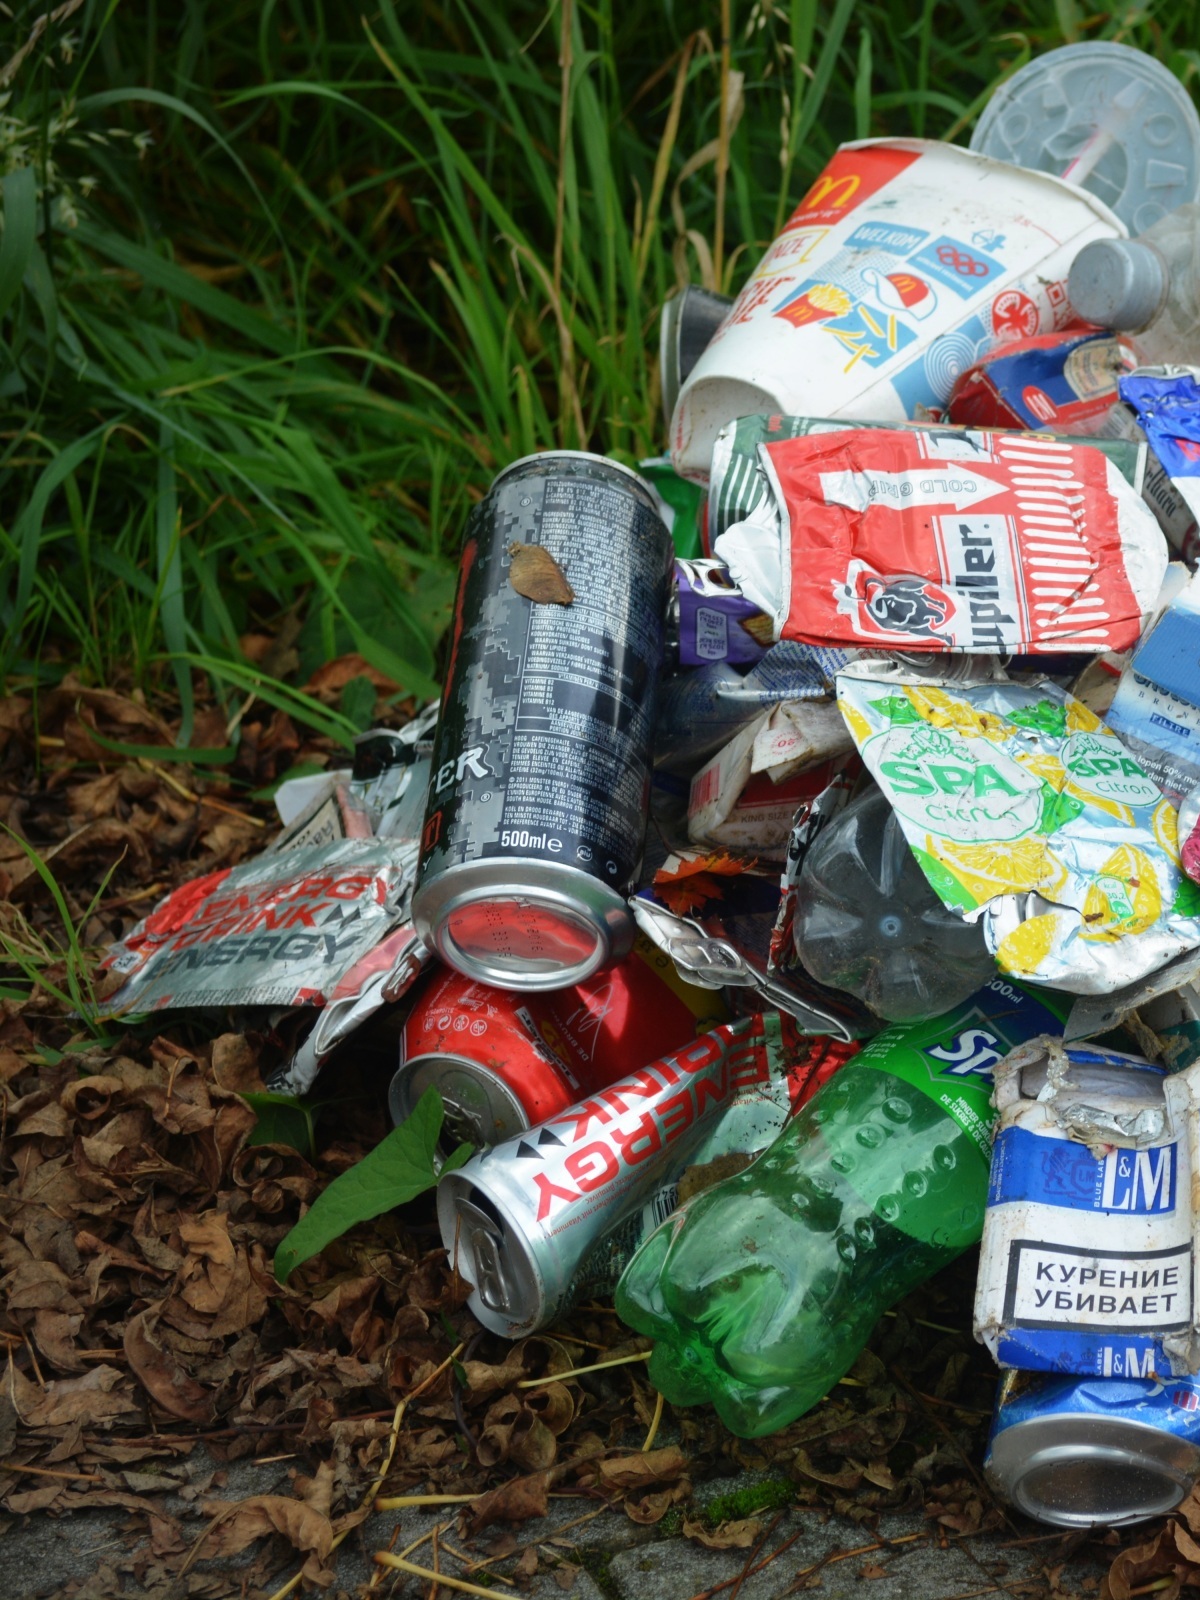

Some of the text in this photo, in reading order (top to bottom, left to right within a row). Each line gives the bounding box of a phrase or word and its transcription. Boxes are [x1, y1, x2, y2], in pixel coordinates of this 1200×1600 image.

[853, 226, 921, 249] WELKOM
[871, 479, 978, 499] COLD GRIP
[1151, 713, 1191, 736] FILTRE
[879, 760, 1022, 800] SPA
[1066, 756, 1148, 780] SPA
[1147, 771, 1165, 784] dan
[1163, 764, 1183, 779] 50%
[1094, 779, 1153, 797] Citron
[740, 809, 788, 824] KING SIZE
[924, 802, 1021, 824] Citron
[501, 830, 547, 850] 500ml
[577, 1046, 590, 1062] DE
[939, 1093, 952, 1107] DE
[950, 1102, 971, 1131] SUCRES
[972, 1129, 982, 1144] DE
[956, 1096, 979, 1122] MINDER
[532, 1043, 771, 1223] ENERGY
[1093, 1158, 1105, 1208] BLUE LAB
[1101, 1145, 1172, 1212] L&M
[548, 1206, 593, 1239] Vitaminen mit
[1035, 1261, 1179, 1290] КУРЕНИЕ
[1034, 1289, 1178, 1315] УБИВАЕТ
[1103, 1344, 1156, 1379] L&M
